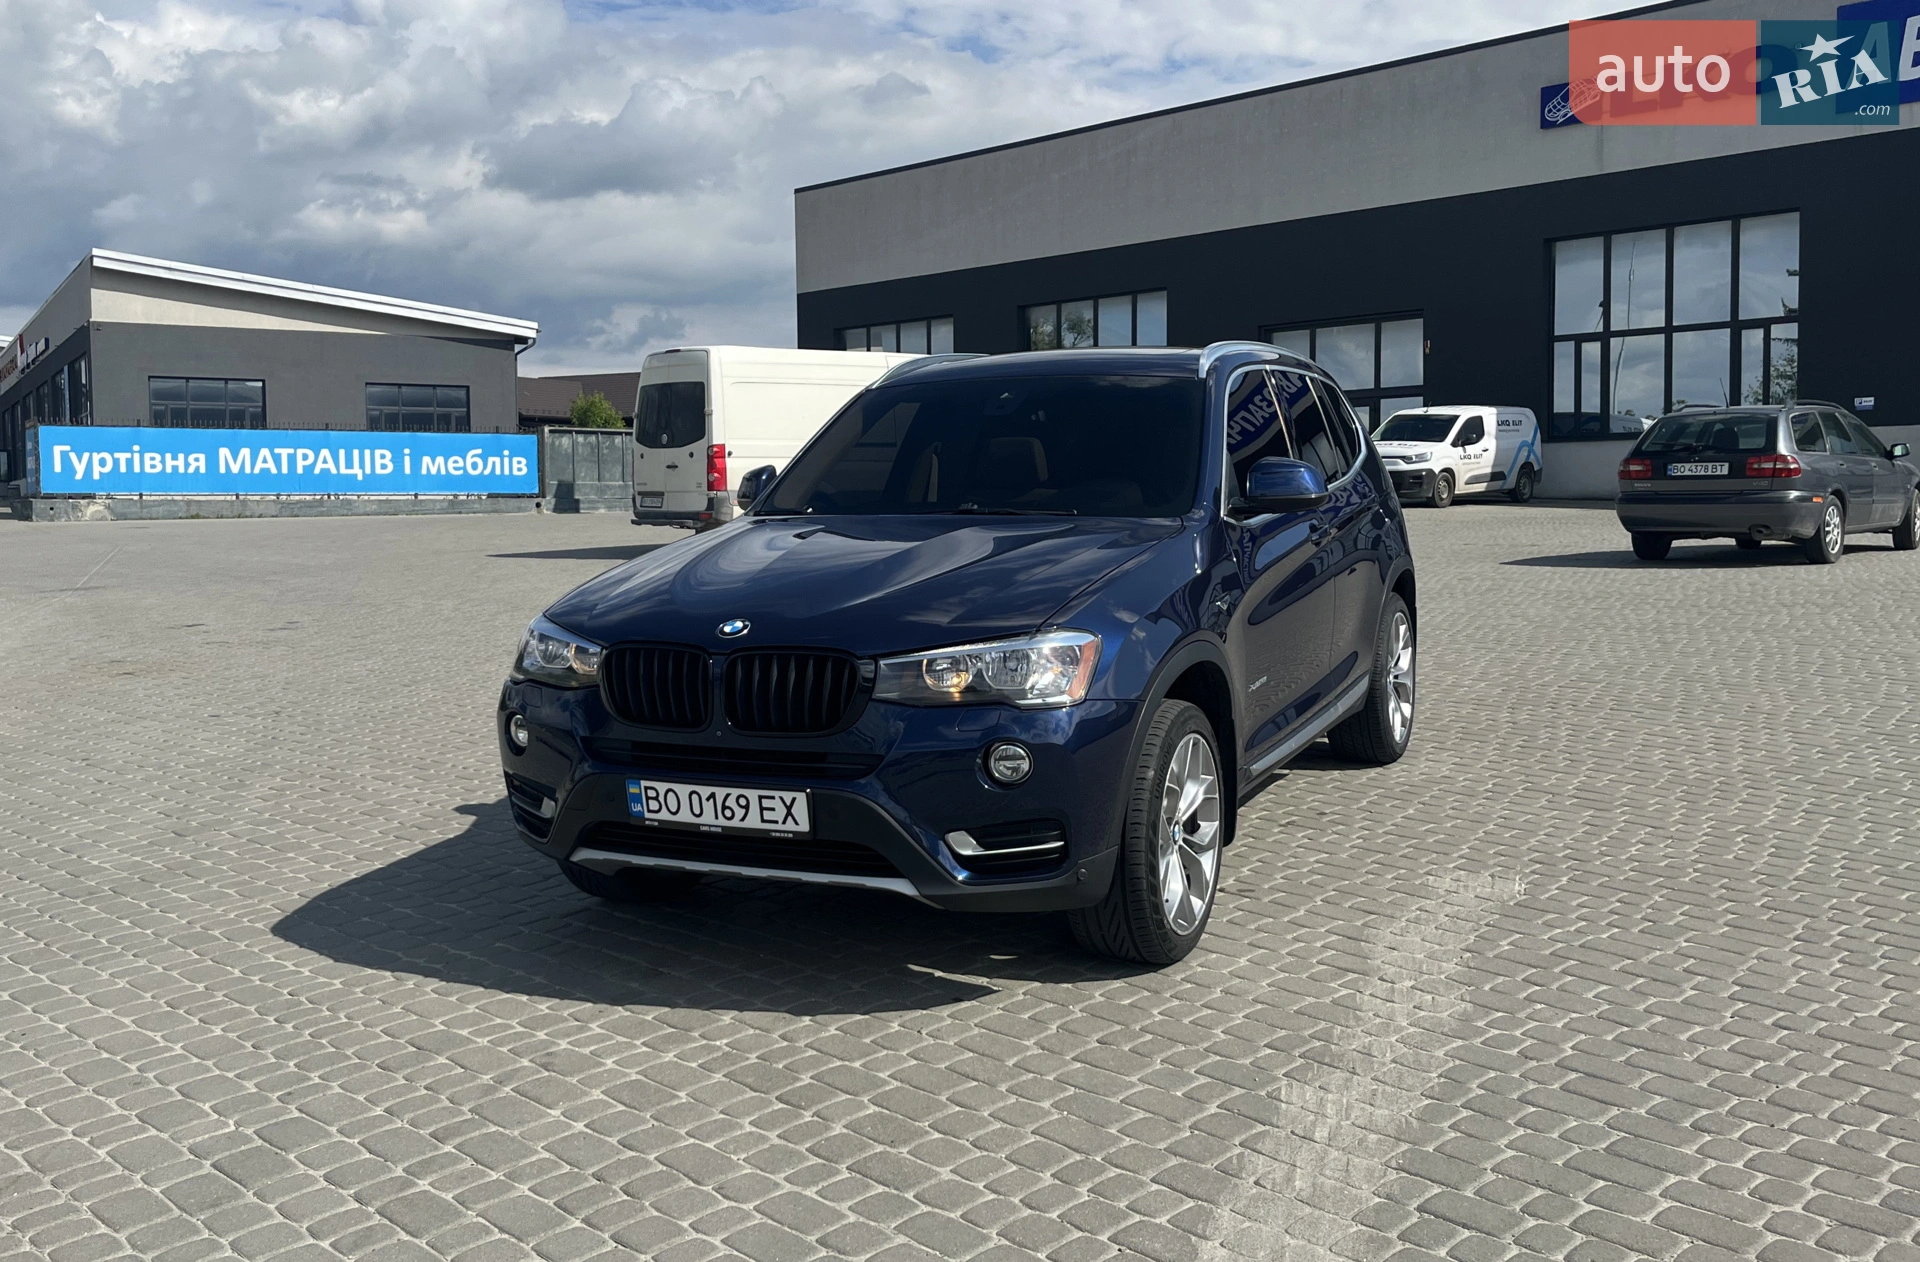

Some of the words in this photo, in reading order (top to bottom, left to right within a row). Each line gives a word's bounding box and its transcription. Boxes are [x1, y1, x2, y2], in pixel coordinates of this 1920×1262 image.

[1497, 419, 1511, 427] LKQ
[52, 443, 206, 480] Гуртівня
[219, 447, 393, 480] МАТРАЦІВ
[404, 448, 411, 475] і
[421, 447, 528, 476] меблів
[1672, 465, 1686, 474] BO
[1688, 465, 1709, 474] 4378
[1710, 464, 1725, 473] BT
[631, 803, 643, 812] UA
[644, 786, 681, 816] BO
[688, 790, 750, 822] 0169
[758, 794, 800, 826] EX
